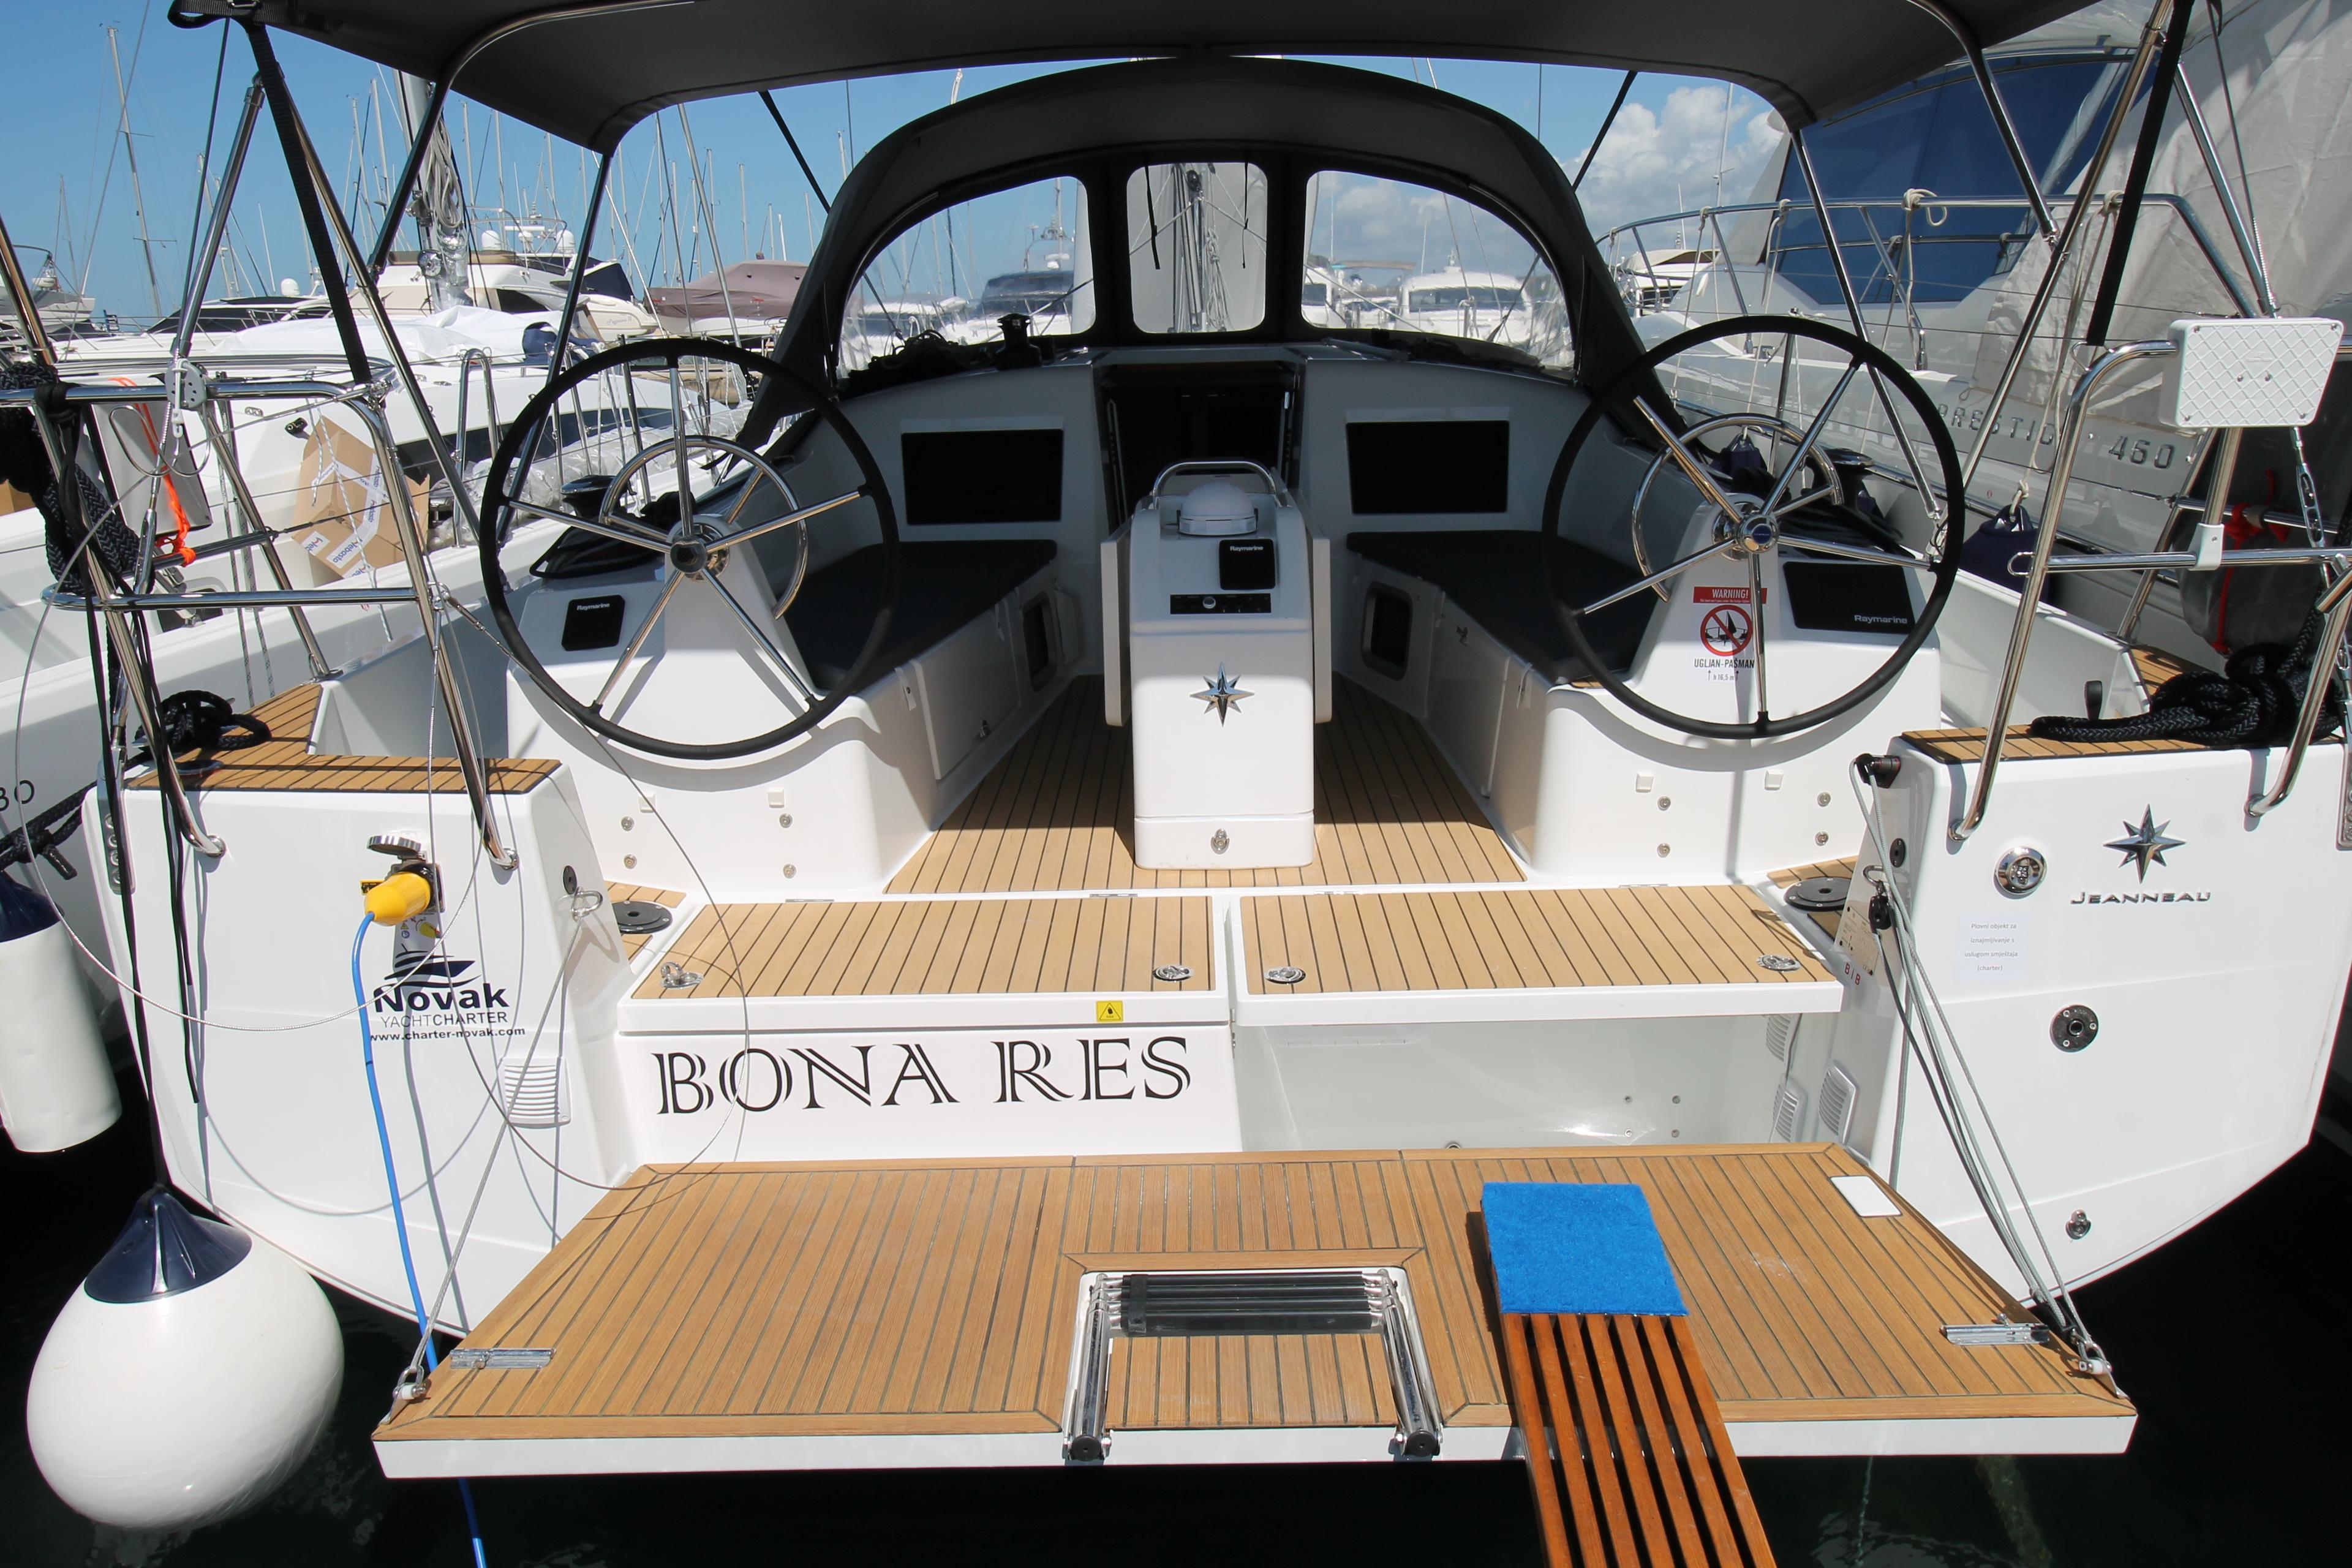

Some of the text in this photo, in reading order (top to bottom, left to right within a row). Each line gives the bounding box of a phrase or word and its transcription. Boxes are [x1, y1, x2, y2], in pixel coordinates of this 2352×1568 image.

[2108, 435, 2174, 469] 460
[1712, 589, 1749, 598] WARNING!
[576, 602, 610, 611] Raymarine
[1854, 614, 1907, 624] Raymarine
[1694, 658, 1755, 669] UGLJAN-PAŠMAN
[2070, 891, 2211, 905] JEANNEAU
[374, 982, 510, 1012] Novak
[370, 1027, 525, 1041] www.charter-novak.com
[651, 1035, 1192, 1115] BONA RES
